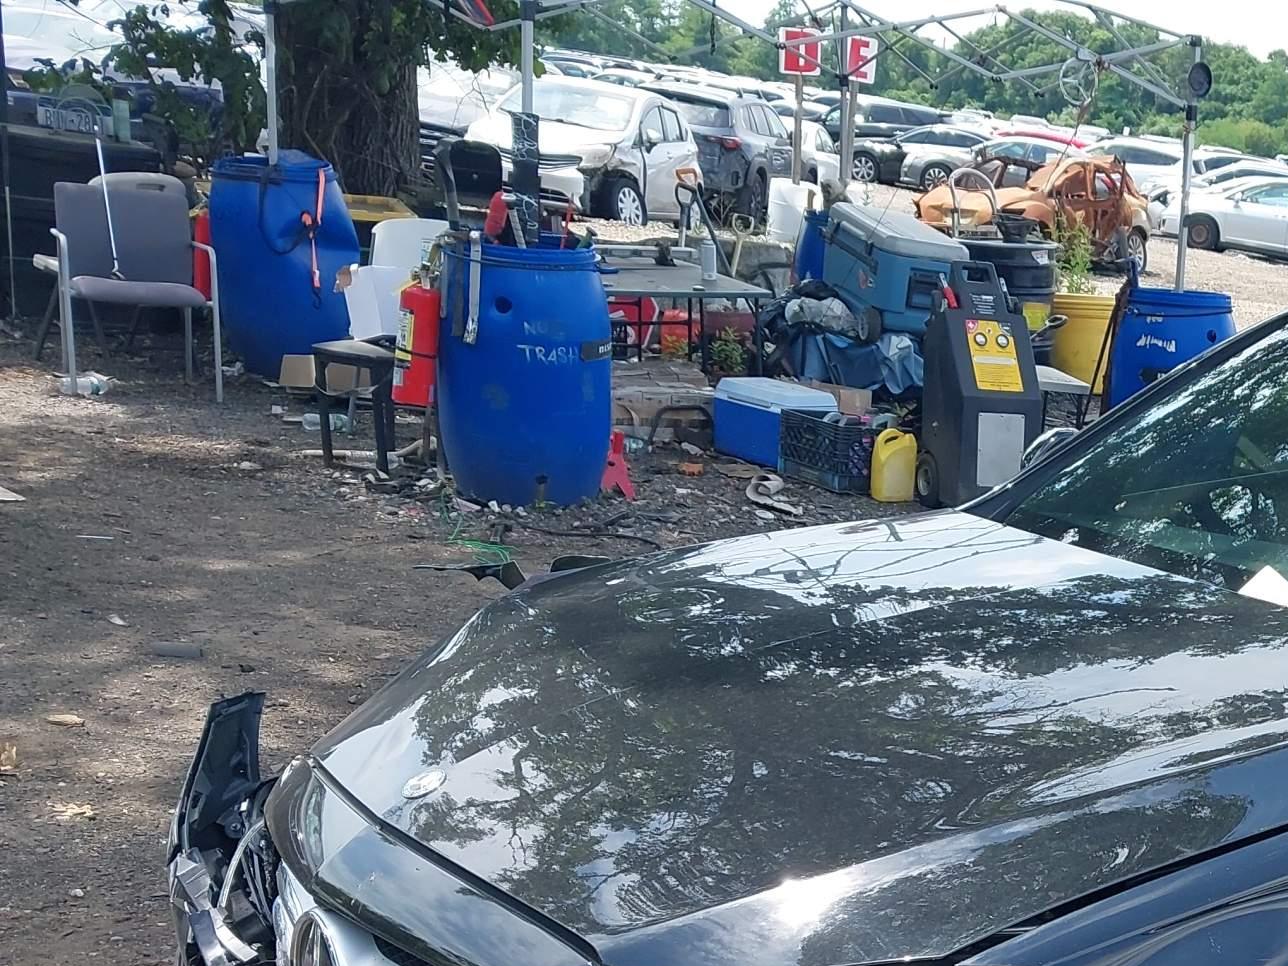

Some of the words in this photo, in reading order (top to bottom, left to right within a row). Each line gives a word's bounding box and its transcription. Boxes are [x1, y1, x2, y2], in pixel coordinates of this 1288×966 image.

[783, 29, 819, 73] D
[848, 37, 870, 79] E
[517, 343, 579, 366] TRASH
